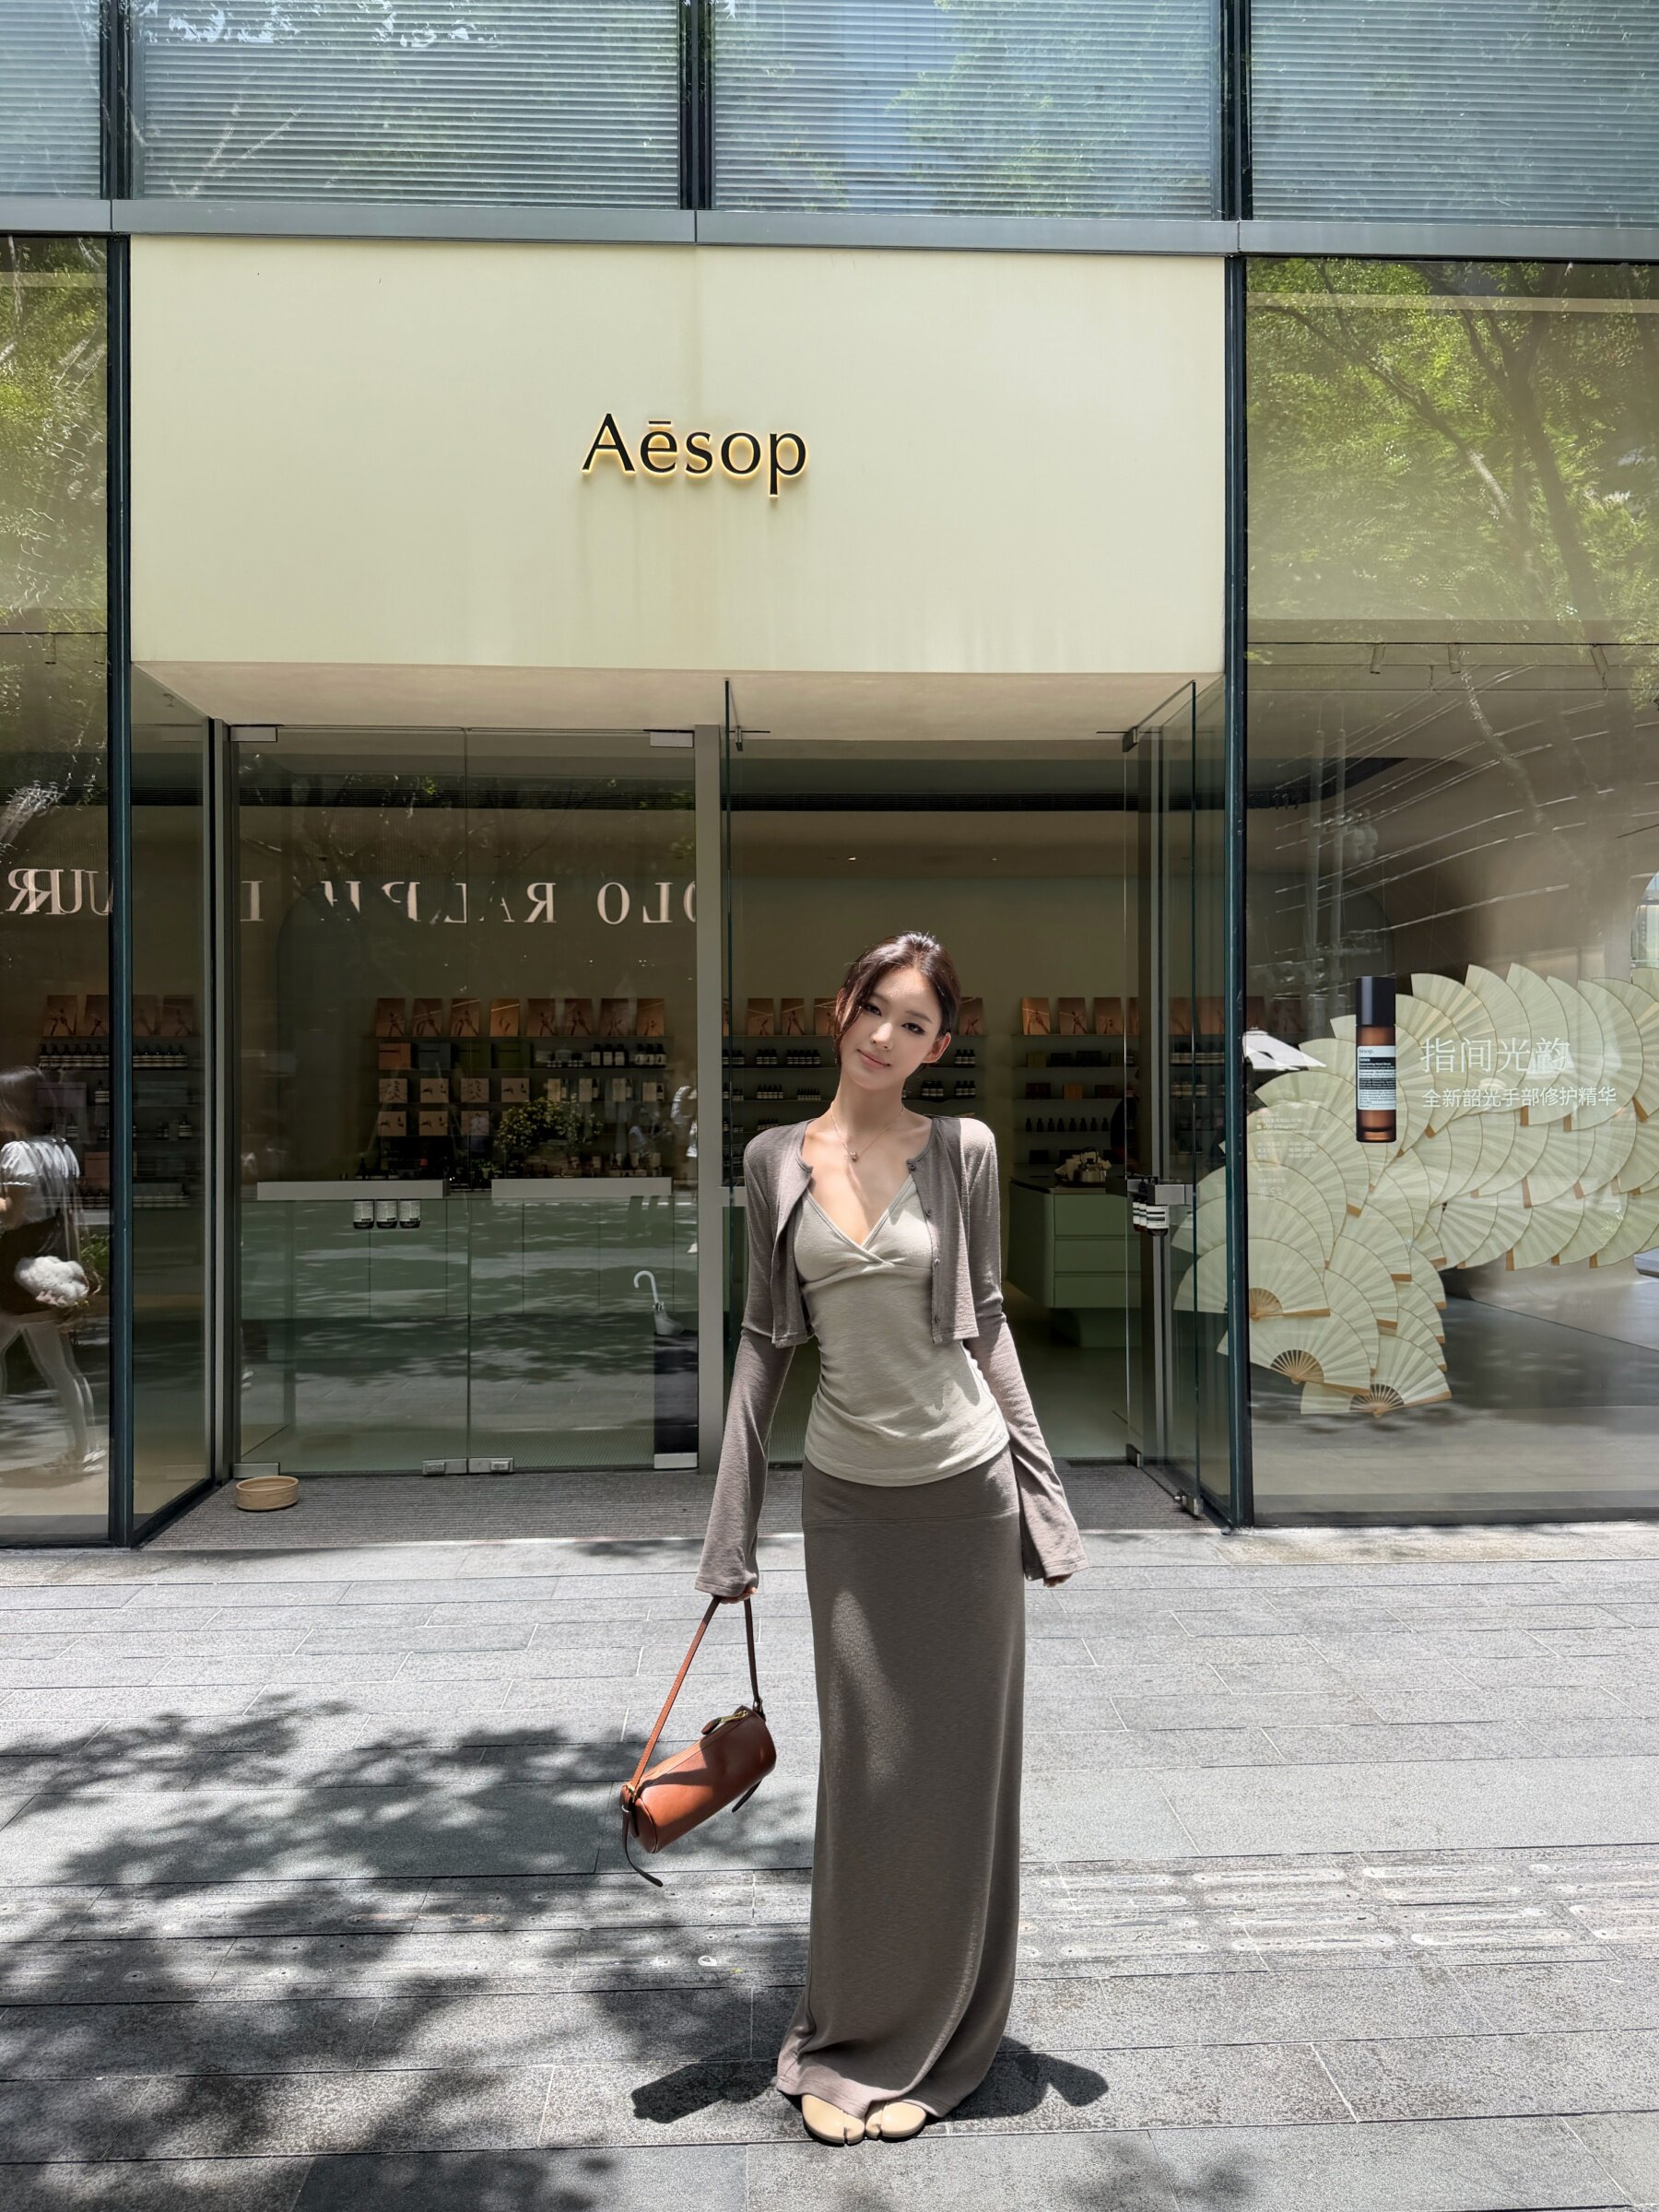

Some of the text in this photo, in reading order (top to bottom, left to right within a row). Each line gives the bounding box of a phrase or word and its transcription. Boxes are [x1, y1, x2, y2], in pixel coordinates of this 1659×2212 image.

[582, 413, 806, 495] Aēsop
[1420, 1037, 1570, 1073] 指间光韵
[1422, 1086, 1617, 1108] 全新韶光手部修护精华
